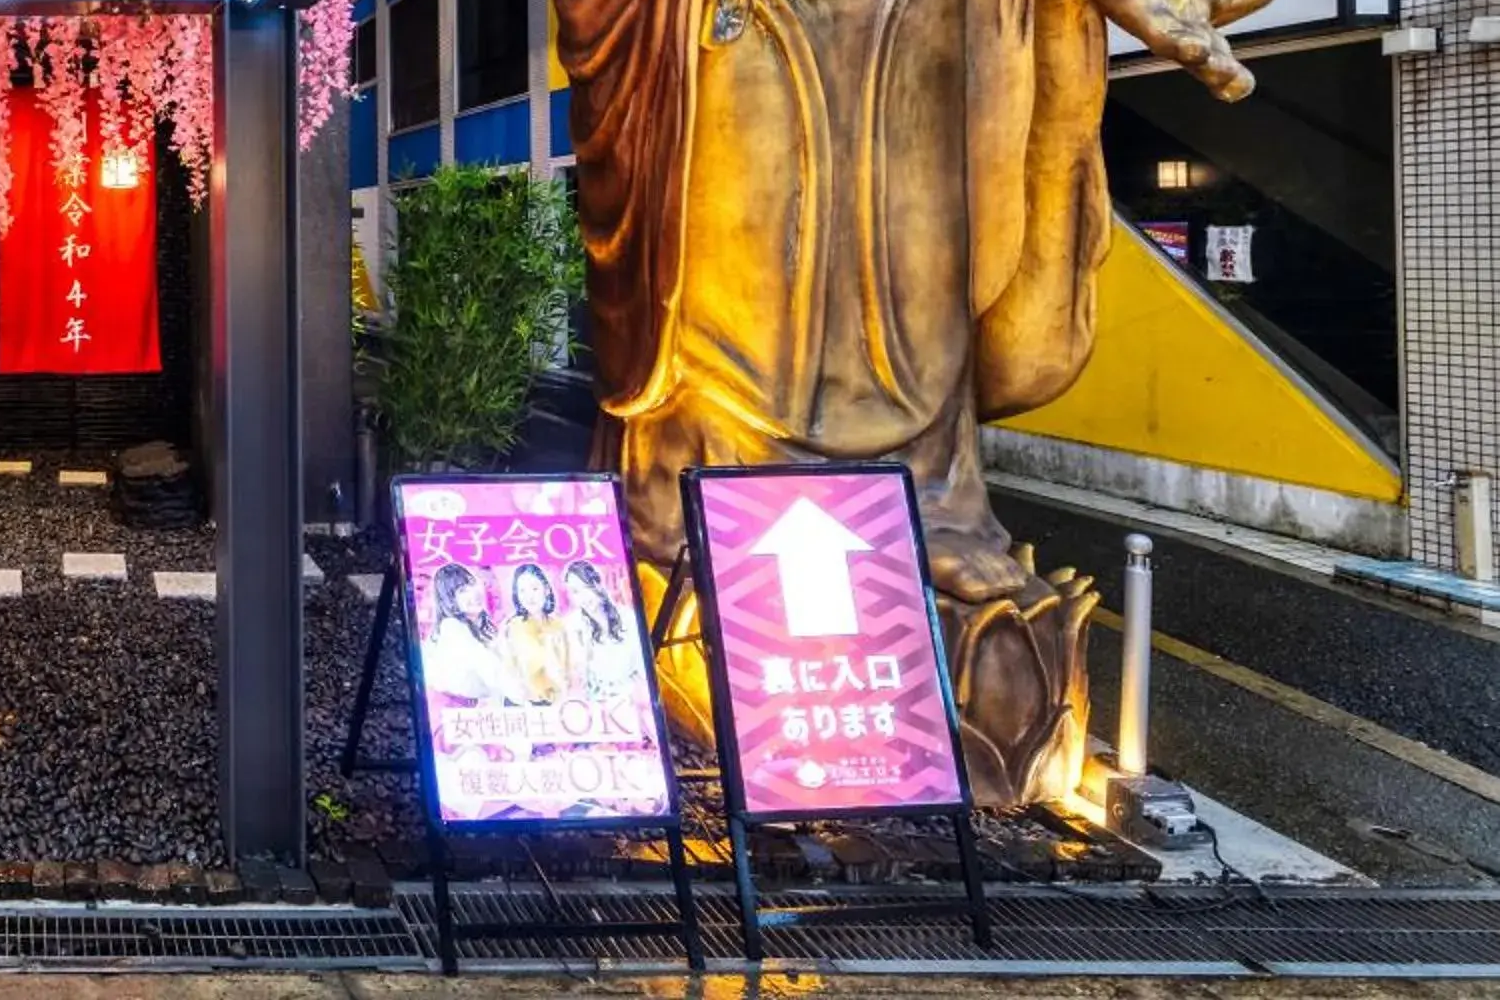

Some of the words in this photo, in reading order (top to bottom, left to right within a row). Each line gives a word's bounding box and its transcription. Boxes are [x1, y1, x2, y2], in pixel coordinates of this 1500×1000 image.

[413, 518, 617, 565] 女子会OK
[451, 698, 634, 739] 女性同士OK
[781, 701, 896, 747] あります
[459, 754, 643, 796] 複数人数OK
